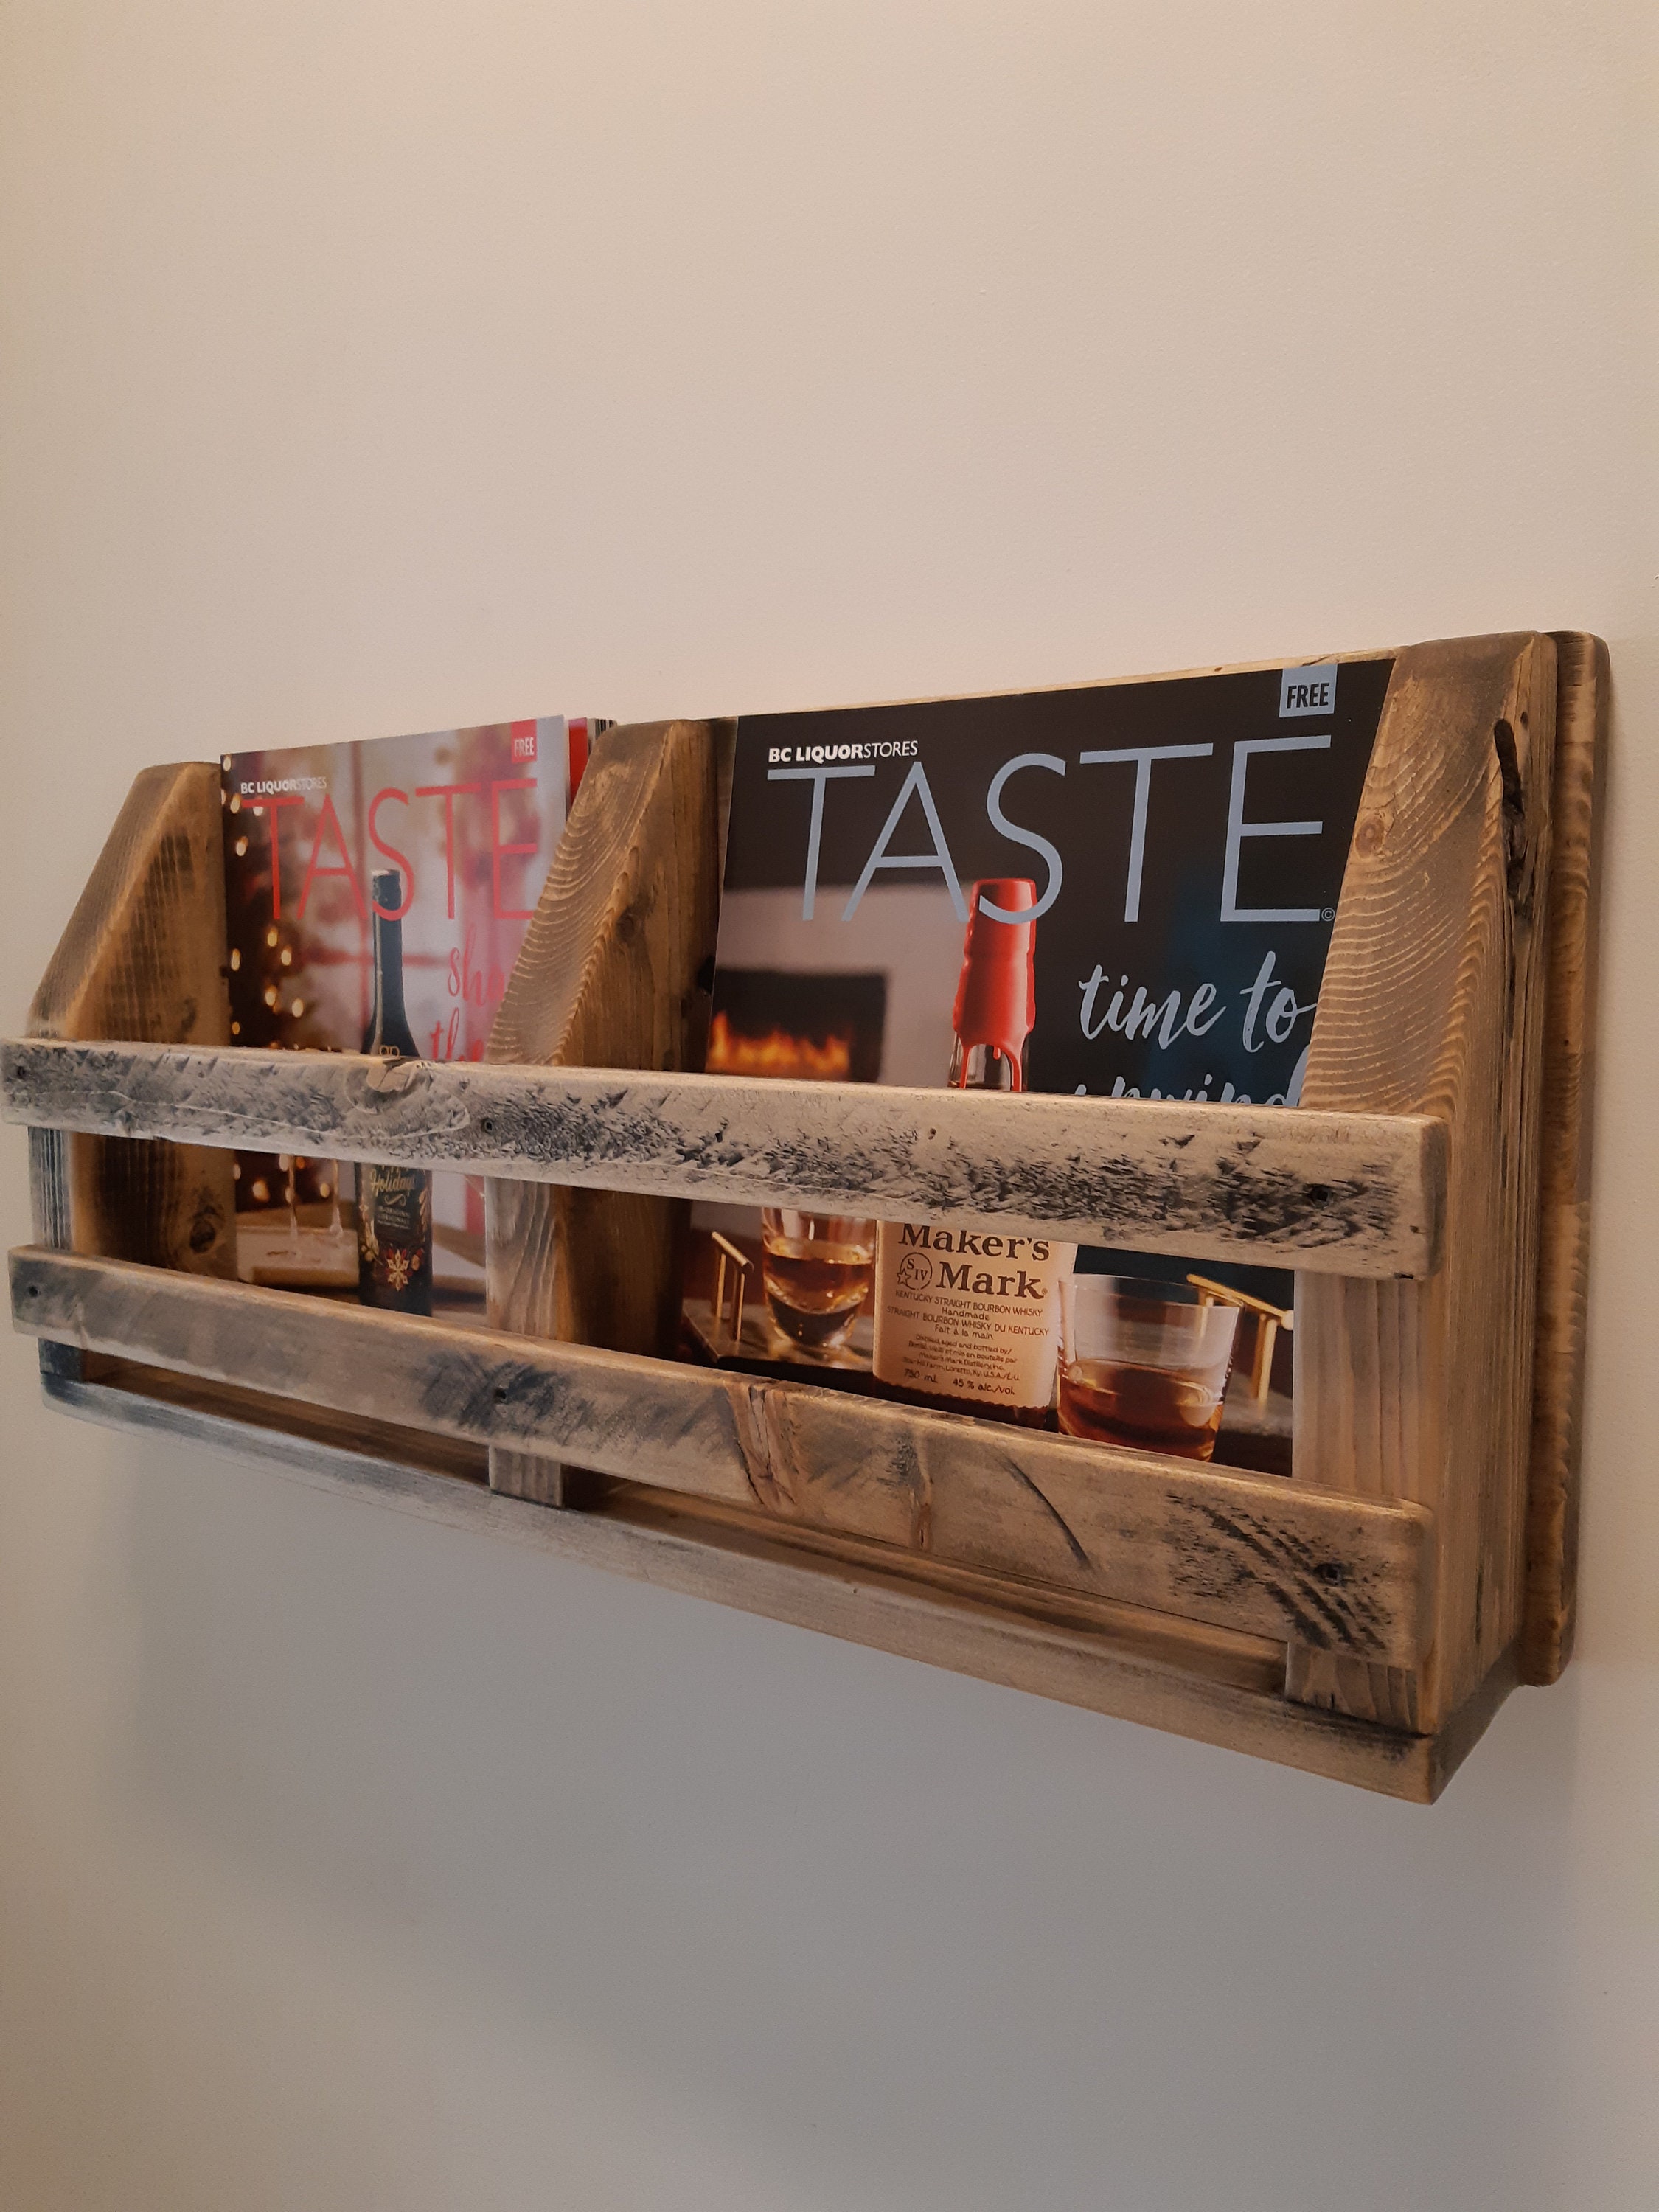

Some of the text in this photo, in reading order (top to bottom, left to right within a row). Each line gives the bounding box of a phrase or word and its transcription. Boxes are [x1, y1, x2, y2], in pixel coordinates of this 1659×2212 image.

[1287, 682, 1329, 709] FREE
[514, 737, 535, 757] FREE
[768, 748, 791, 763] BC
[240, 782, 255, 794] BC
[767, 735, 1332, 925] TASTE
[241, 778, 537, 921] TASTE
[1078, 950, 1318, 1053] time to
[898, 1223, 1050, 1262] Maker's
[936, 1261, 1045, 1300] Mark
[895, 1290, 1043, 1317] KENTUCKY STRAIGHT BOURBON WHISKY
[942, 1307, 990, 1321] Handmade
[887, 1305, 1050, 1336] STRAIGHT BOURBON WHISKY DU KENTUCKY
[935, 1324, 951, 1334] Fait
[961, 1328, 970, 1337] la
[972, 1331, 994, 1340] main
[974, 1345, 998, 1353] bottled
[904, 1368, 920, 1379] 750
[953, 1378, 964, 1388] 45
[967, 1380, 975, 1389] %
